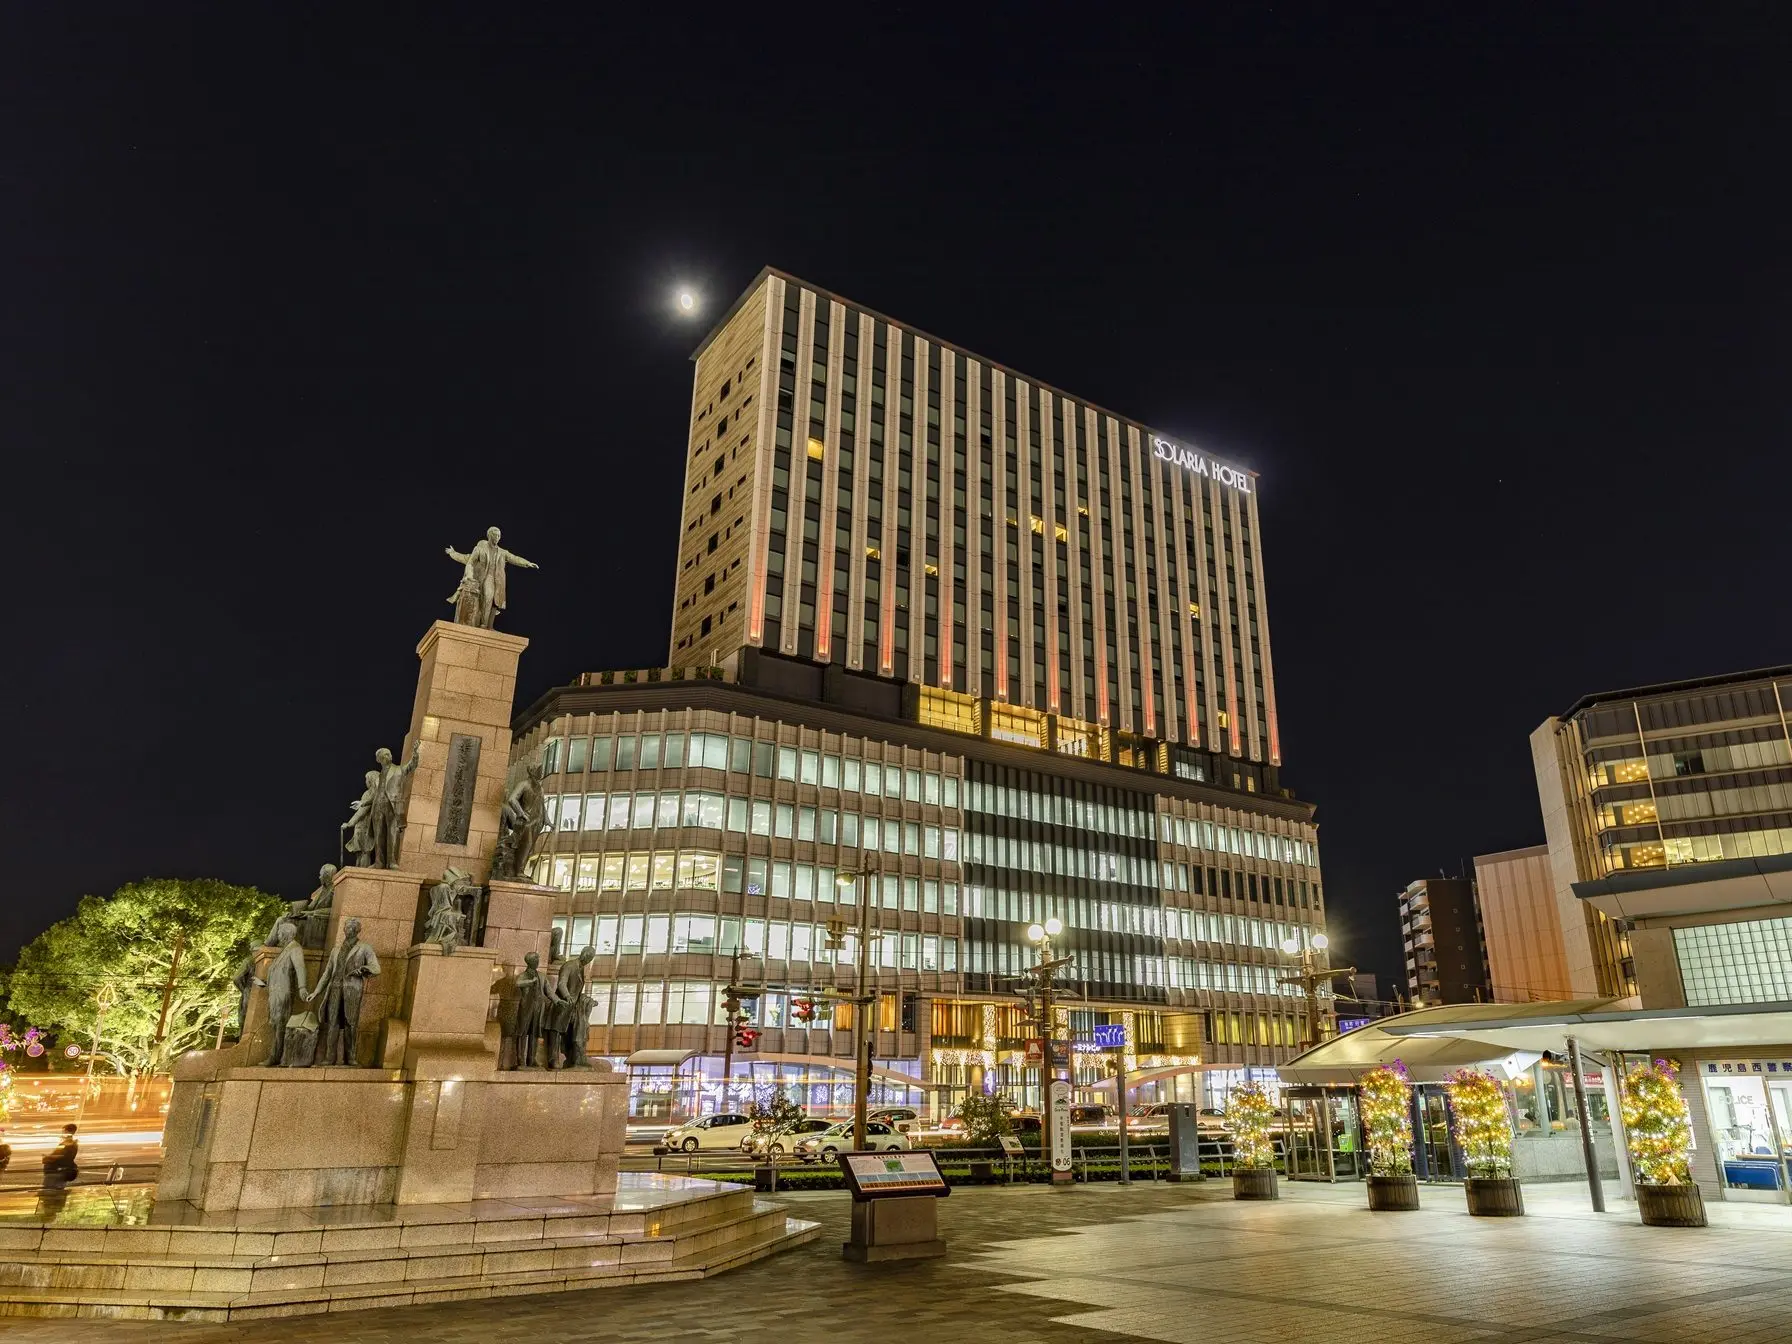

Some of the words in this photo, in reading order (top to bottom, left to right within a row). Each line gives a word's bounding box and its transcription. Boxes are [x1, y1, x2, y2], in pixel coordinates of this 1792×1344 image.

[1153, 438, 1209, 477] SOLARIA
[1212, 461, 1251, 493] HOTEL
[68, 1047, 78, 1055] 50
[1719, 1095, 1755, 1105] POLICE
